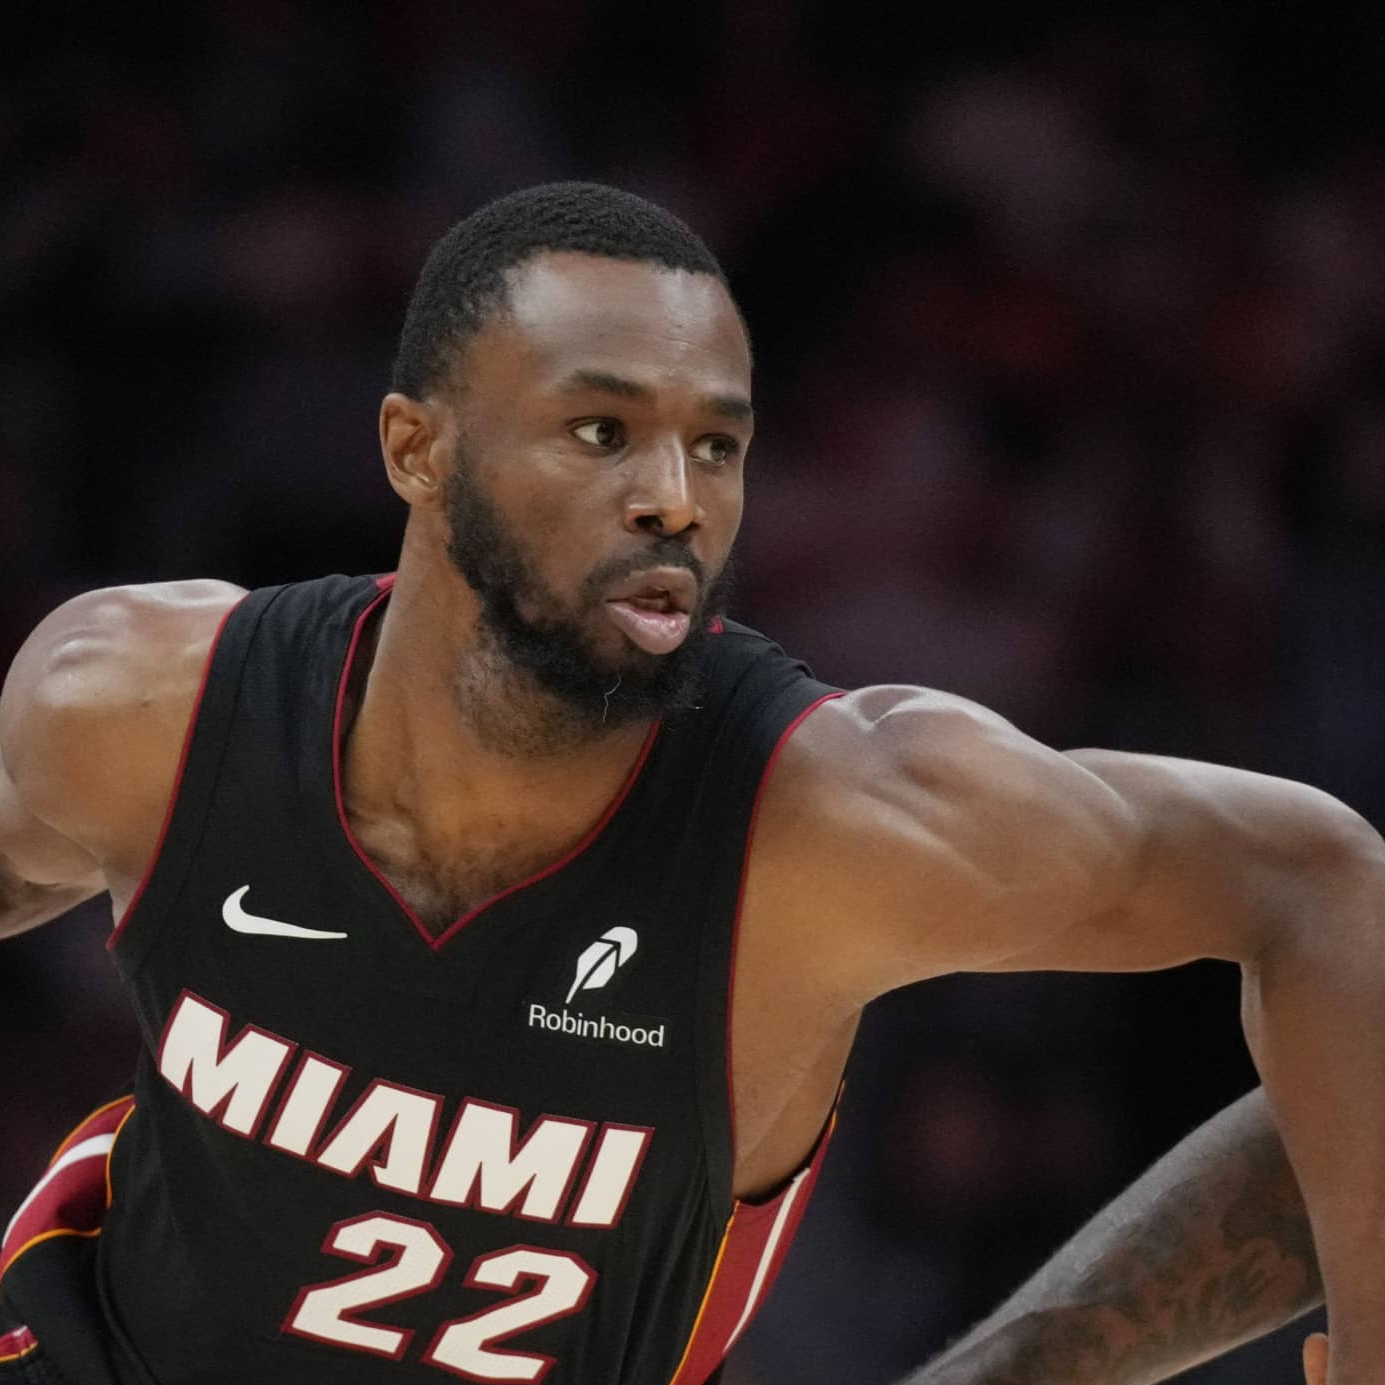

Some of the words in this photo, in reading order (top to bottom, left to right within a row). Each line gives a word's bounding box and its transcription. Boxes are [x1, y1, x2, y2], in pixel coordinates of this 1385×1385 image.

[157, 988, 656, 1229] MIAMI
[527, 1004, 666, 1049] Robinhood
[281, 1210, 599, 1385] 22
